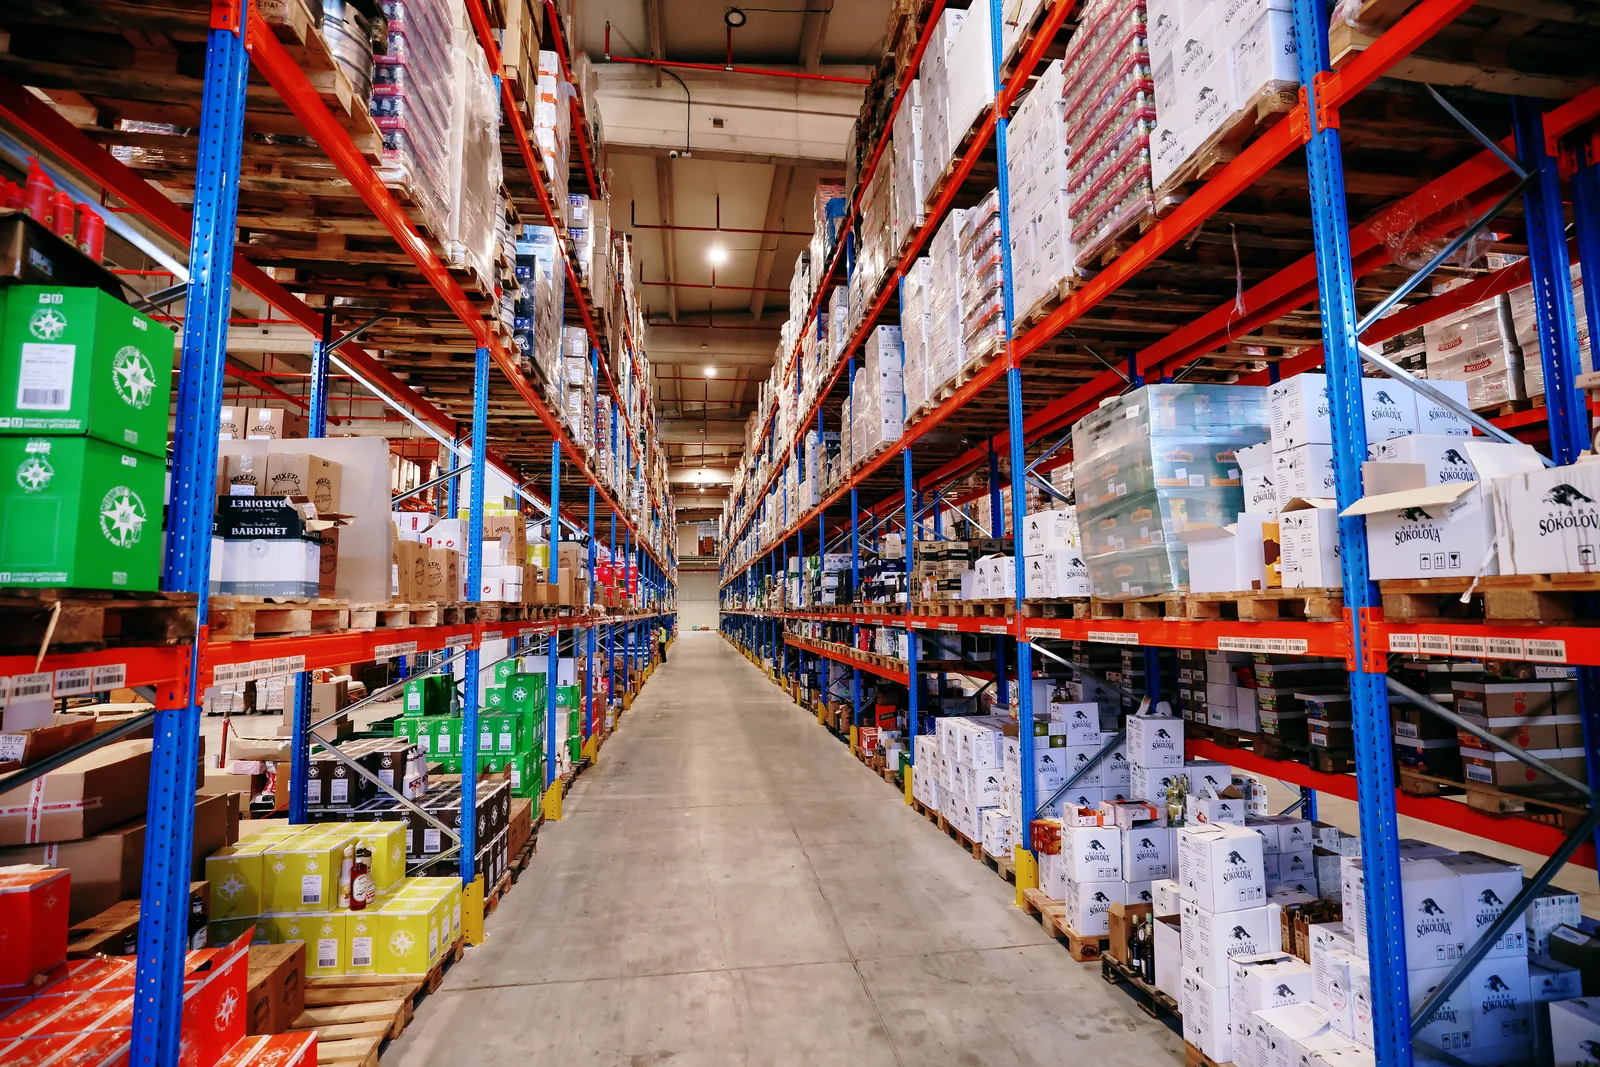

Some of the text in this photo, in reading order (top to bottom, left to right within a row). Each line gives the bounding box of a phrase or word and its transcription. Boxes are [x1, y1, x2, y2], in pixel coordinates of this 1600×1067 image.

[1372, 410, 1402, 422] SOKOLOVA
[272, 472, 300, 484] MIXER
[1440, 472, 1474, 484] SOKOLOVA
[230, 500, 286, 508] BARDINET
[1549, 508, 1596, 518] STARA
[1539, 514, 1600, 536] SOKOLOV
[231, 528, 288, 536] BARDINET
[1395, 528, 1441, 546] SOKOLOVA
[1152, 742, 1176, 750] SOKOLOVA
[1084, 854, 1110, 864] SOKOLOVA
[1136, 852, 1160, 862] SOKOLOVA
[1223, 870, 1252, 884] SOKOLOVA
[1416, 922, 1452, 938] SOKOLOVA
[1227, 944, 1257, 960] SOKOLOVA
[1482, 999, 1517, 1014] SOKOLOVA
